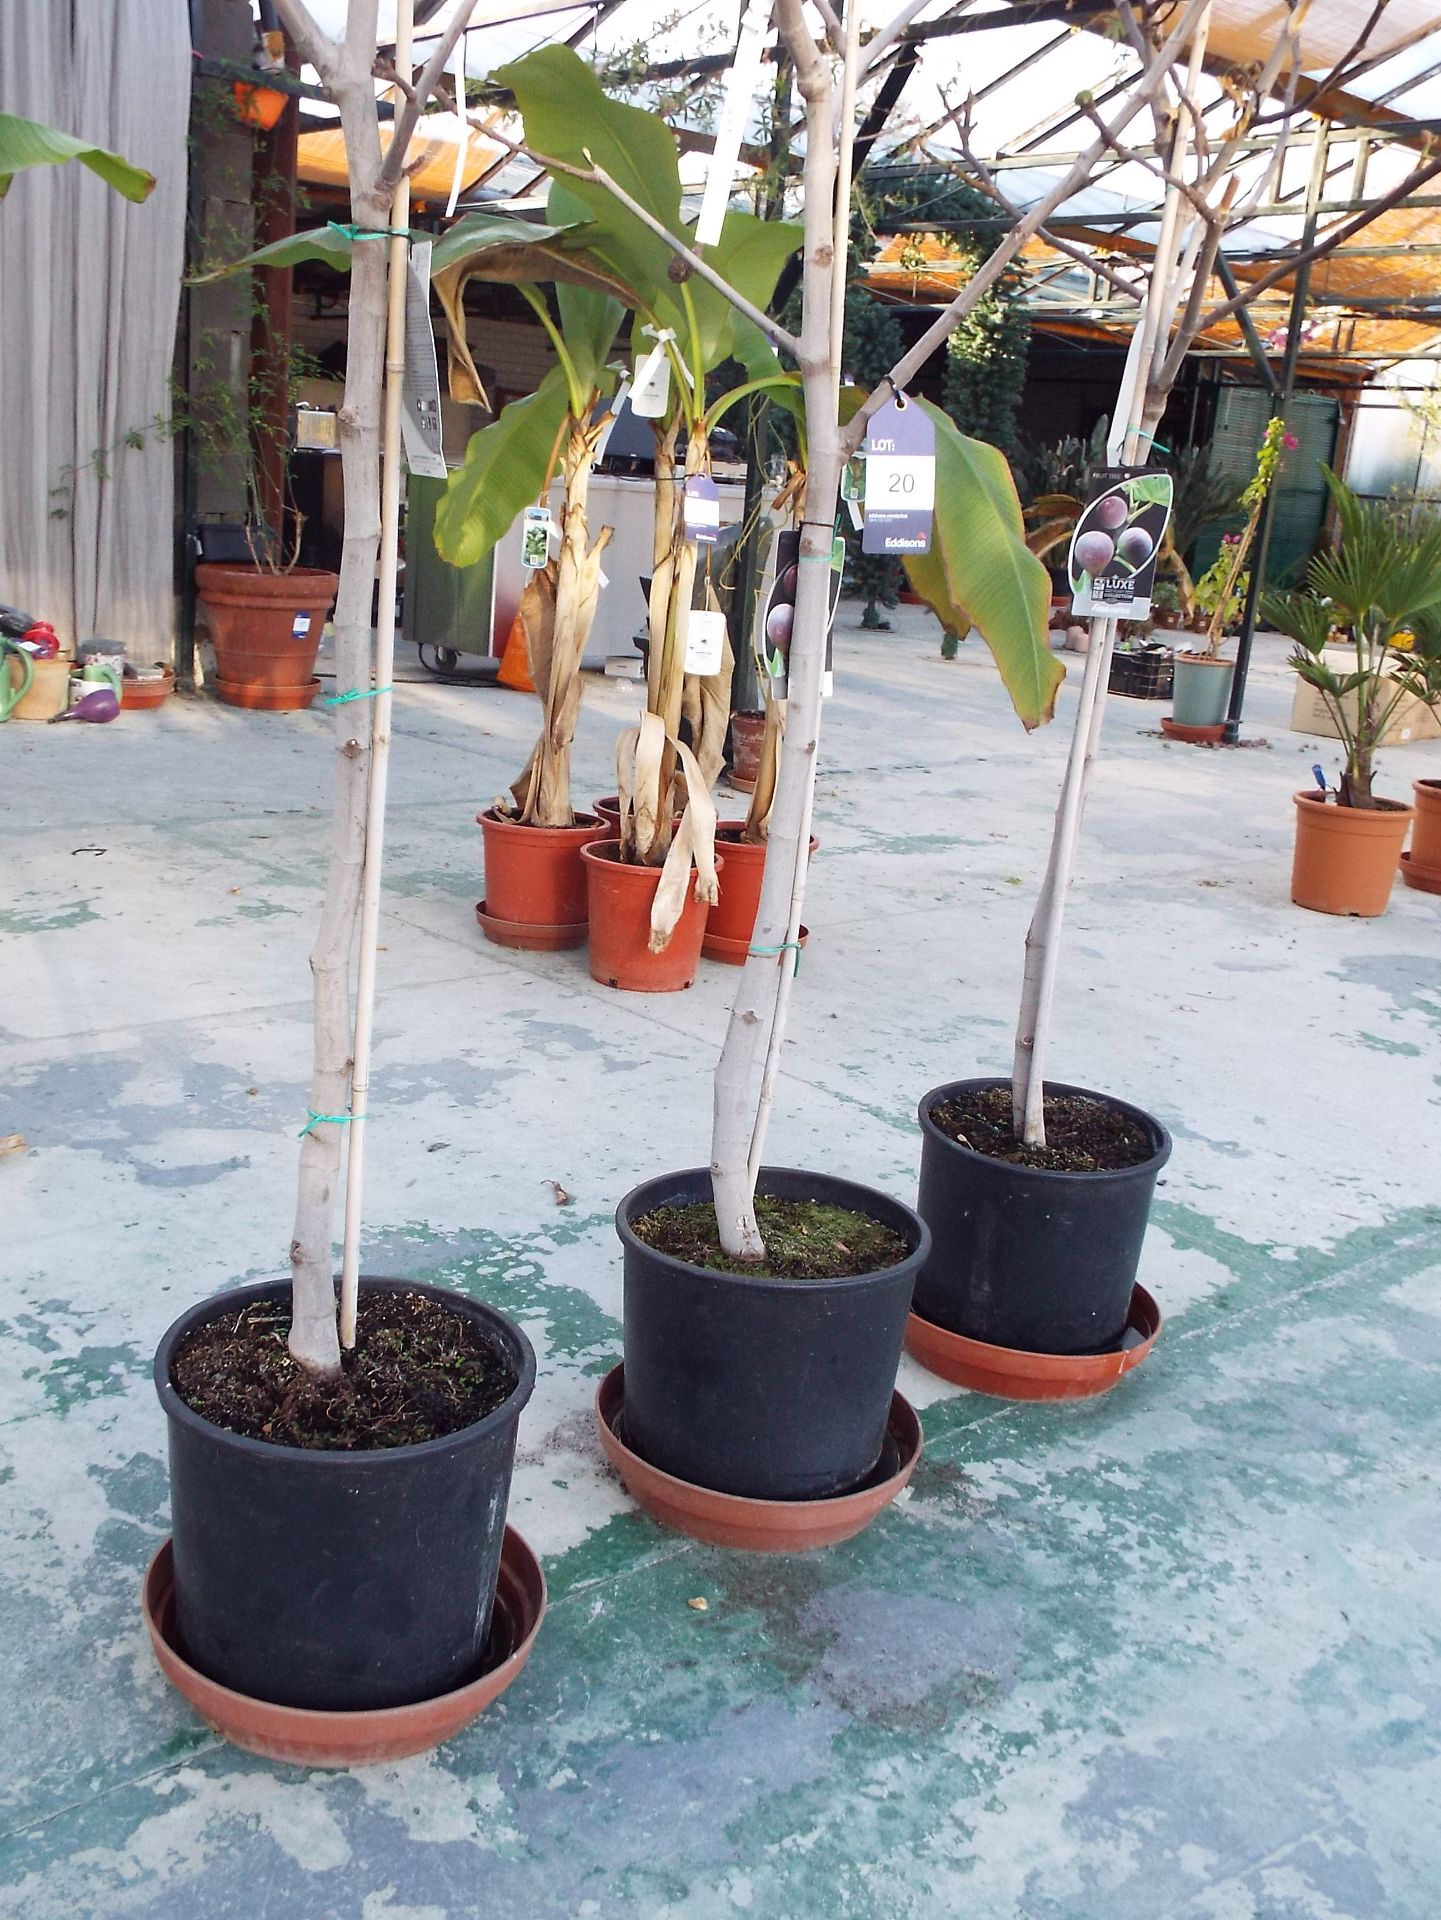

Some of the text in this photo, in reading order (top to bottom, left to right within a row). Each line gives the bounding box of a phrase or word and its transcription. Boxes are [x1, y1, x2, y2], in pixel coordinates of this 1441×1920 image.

[871, 439, 896, 451] LOT:
[889, 473, 915, 493] 20
[885, 537, 926, 548] Eddisons
[1106, 579, 1136, 590] LUXE
